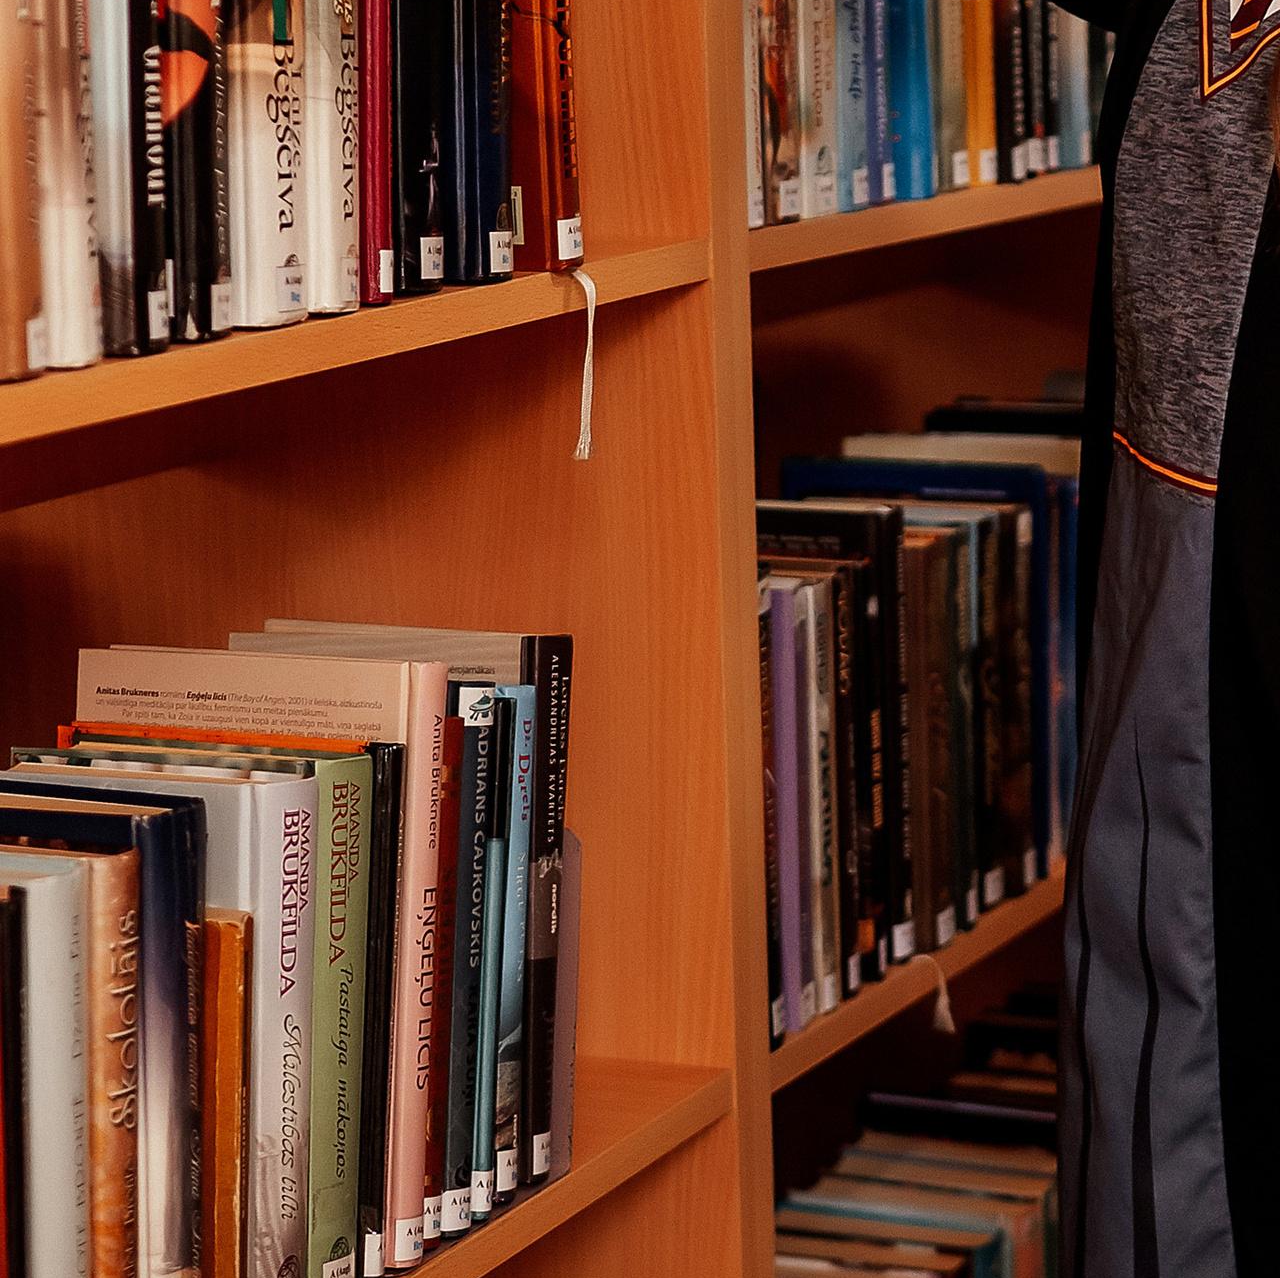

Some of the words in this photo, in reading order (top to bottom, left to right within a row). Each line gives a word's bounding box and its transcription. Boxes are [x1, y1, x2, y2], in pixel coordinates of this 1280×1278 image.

[96, 686, 120, 696] Anitas
[121, 687, 159, 699] Brukneres
[433, 715, 443, 762] Anita
[549, 655, 560, 765] ALEKSANDRIJAS
[428, 768, 441, 850] Bruknere
[476, 726, 490, 825] ADRIANS
[547, 774, 557, 844] KVARTETS
[298, 808, 312, 912] AMANDA
[328, 780, 350, 967] BRUKFĪLDA
[349, 782, 362, 884] AMANDA
[279, 808, 302, 999] BRUKFĪLDA
[414, 887, 438, 1007] EŅĢEĻU
[330, 963, 354, 1068] Pastaiga
[281, 1014, 302, 1169] Mīlestības
[332, 1078, 351, 1180] mākoņos
